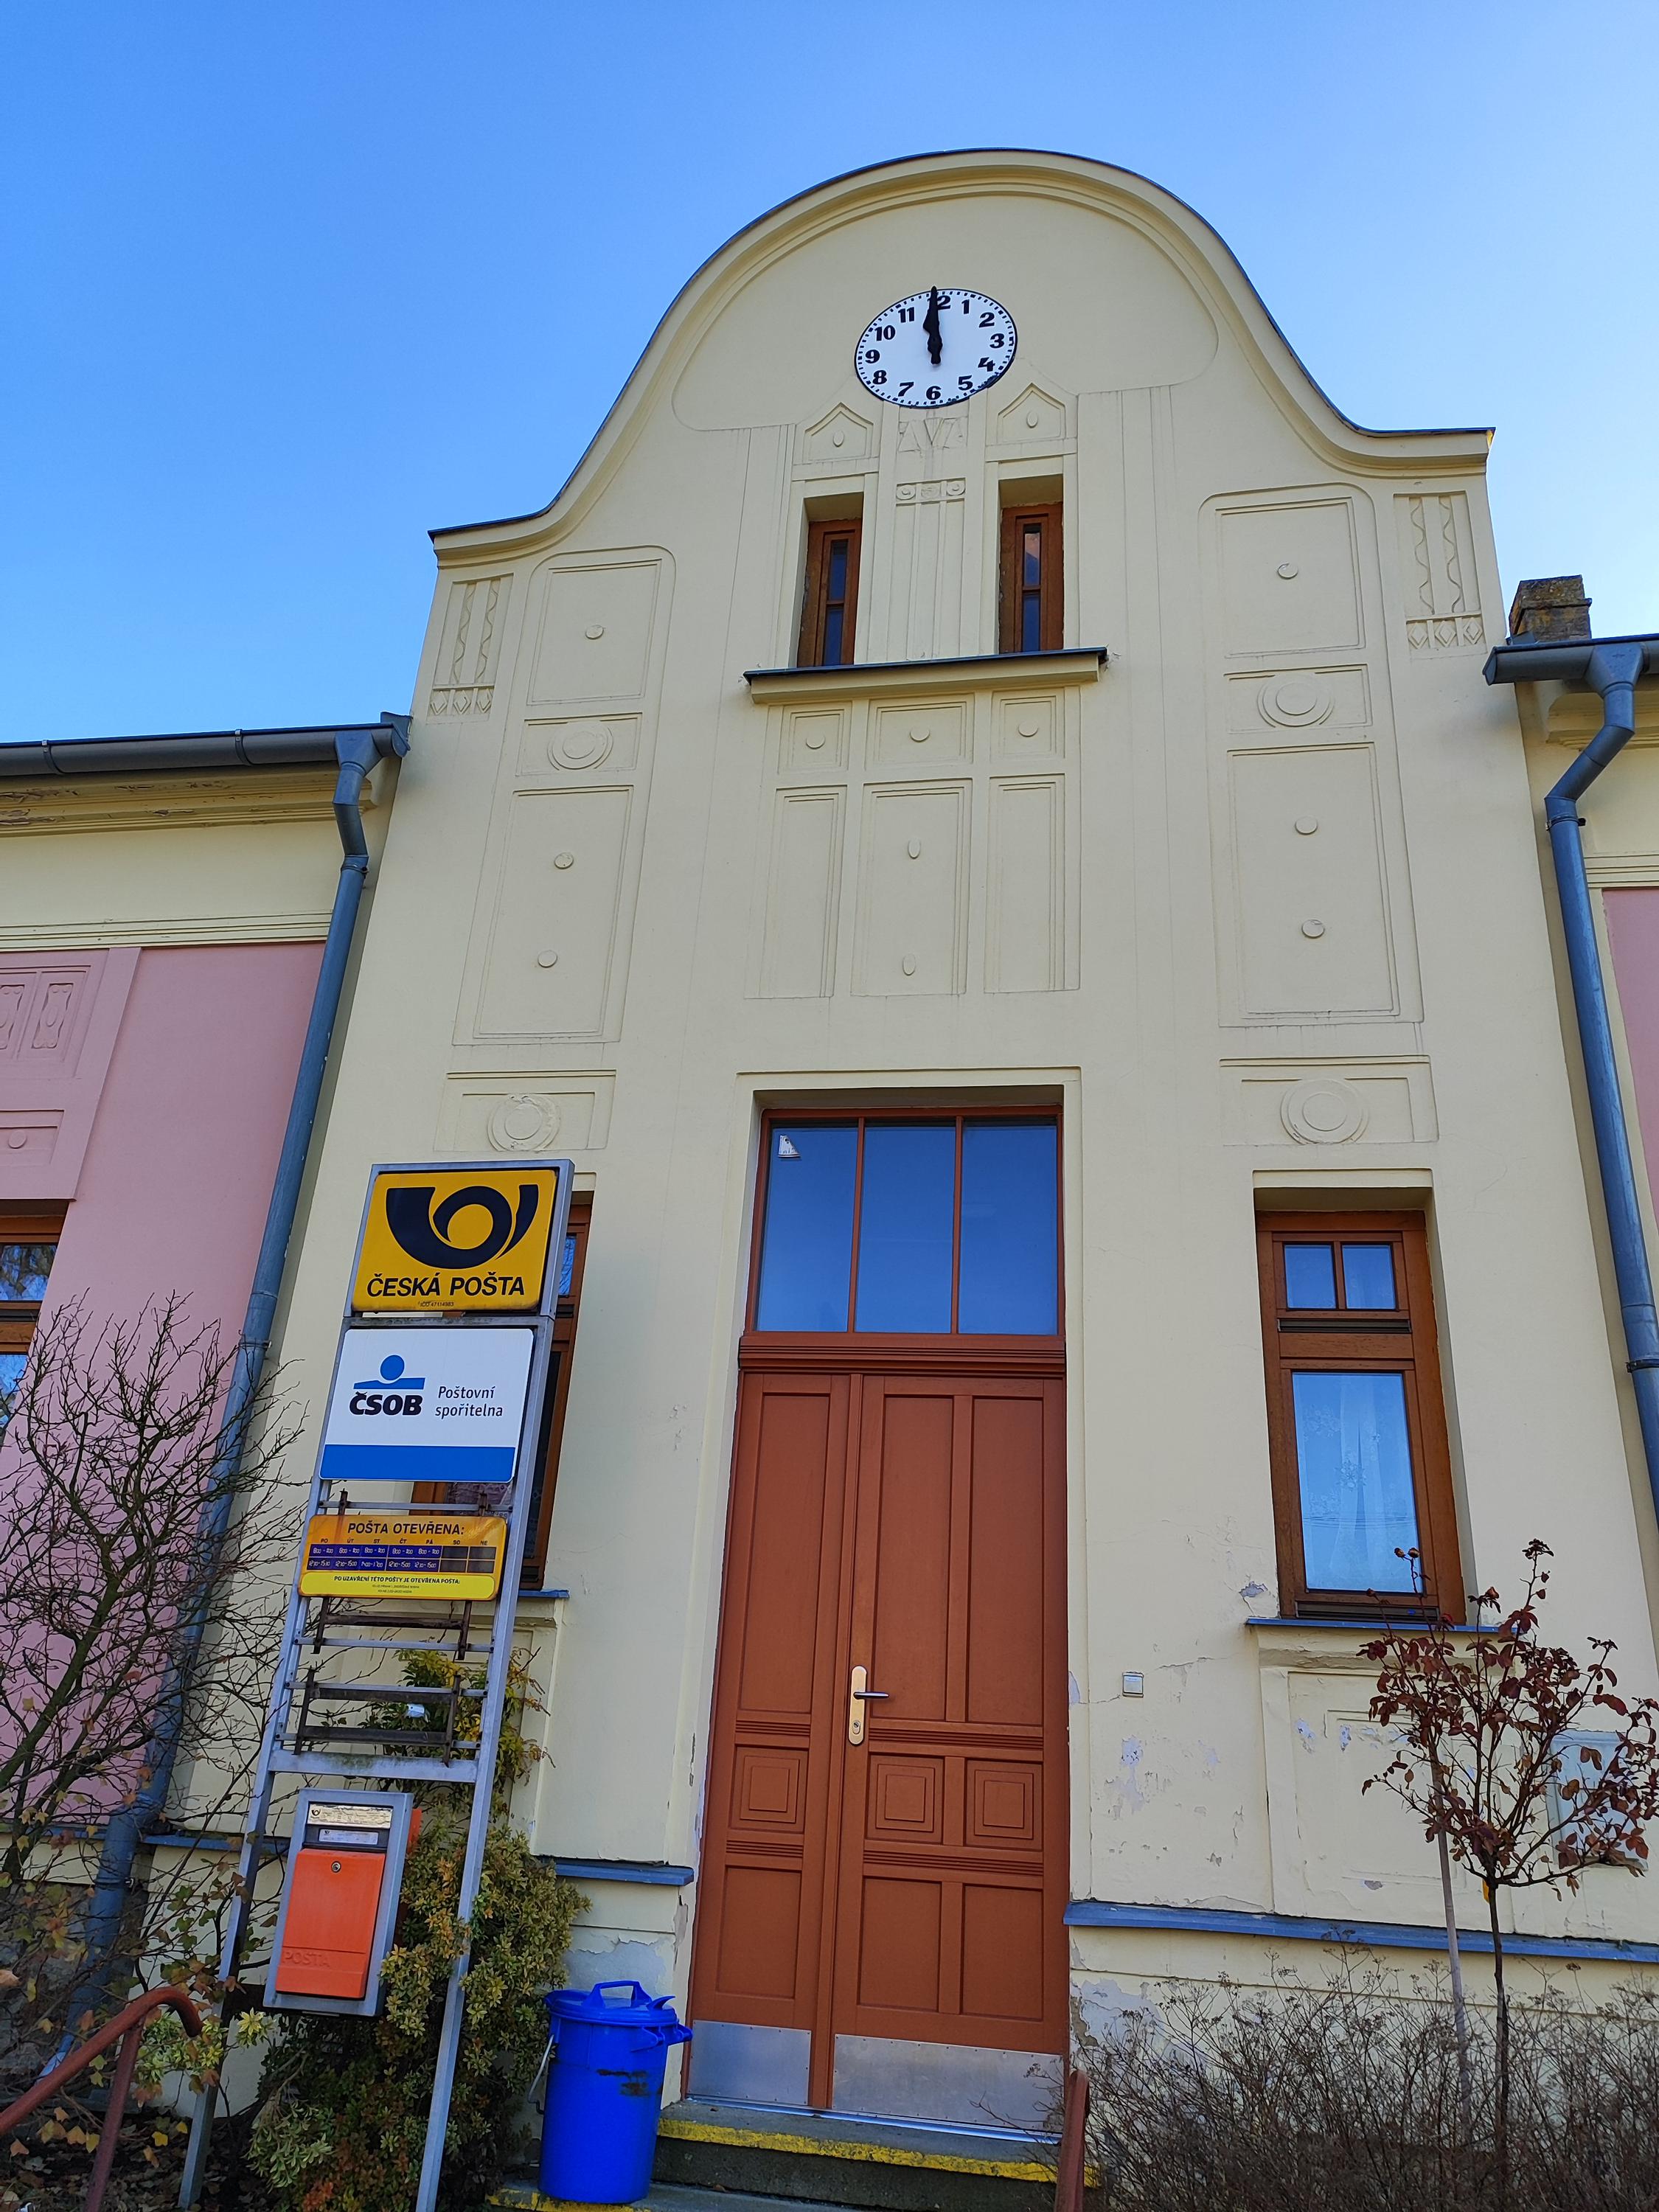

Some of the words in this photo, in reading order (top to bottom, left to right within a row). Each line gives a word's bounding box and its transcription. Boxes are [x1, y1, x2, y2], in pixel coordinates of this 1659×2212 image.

[928, 295, 951, 310] 2
[961, 299, 970, 314] 1
[898, 307, 915, 323] 11
[978, 312, 995, 327] 2
[874, 324, 896, 341] 10
[990, 333, 1005, 349] 3
[865, 349, 880, 364] 9
[978, 357, 995, 372] 4
[872, 370, 887, 385] 8
[959, 375, 973, 391] 5
[897, 382, 914, 397] 7
[926, 386, 941, 400] 6
[367, 1272, 441, 1297] ČESKÁ
[449, 1271, 524, 1296] POŠTA
[438, 1385, 495, 1399] Poštovní
[349, 1391, 423, 1416] ČSOB
[435, 1403, 503, 1419] spořitelna
[347, 1520, 389, 1534] POŠTA
[393, 1521, 465, 1535] OTEVŘENA:
